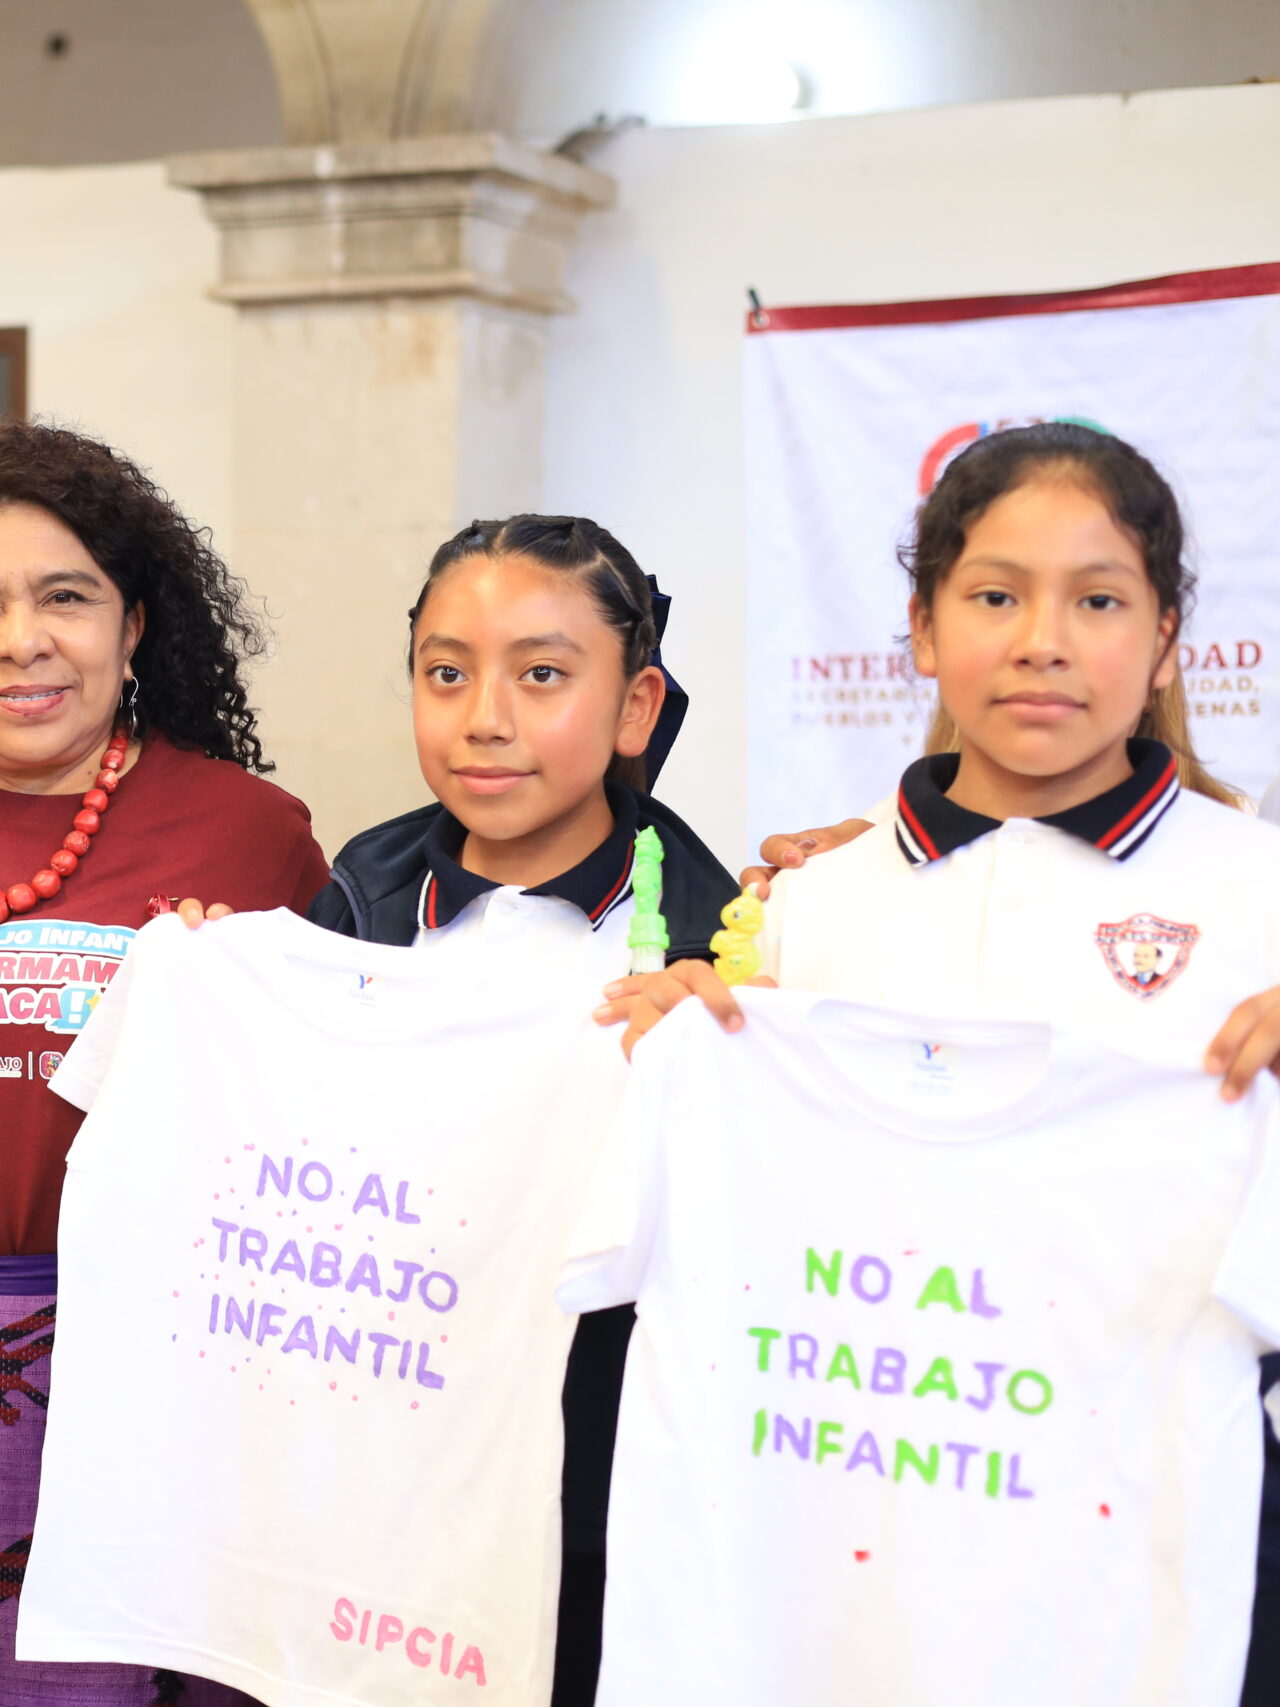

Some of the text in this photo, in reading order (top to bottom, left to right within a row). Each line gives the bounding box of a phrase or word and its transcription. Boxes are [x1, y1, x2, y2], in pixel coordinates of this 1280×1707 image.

[256, 1153, 421, 1224] NO AL
[212, 1217, 458, 1313] TRABAJO
[806, 1247, 1002, 1319] NO AL
[209, 1294, 445, 1390] INFANTIL
[747, 1327, 1053, 1415] TRABAJO
[752, 1408, 1034, 1499] INFANTIL
[329, 1597, 487, 1687] SIPCIA
